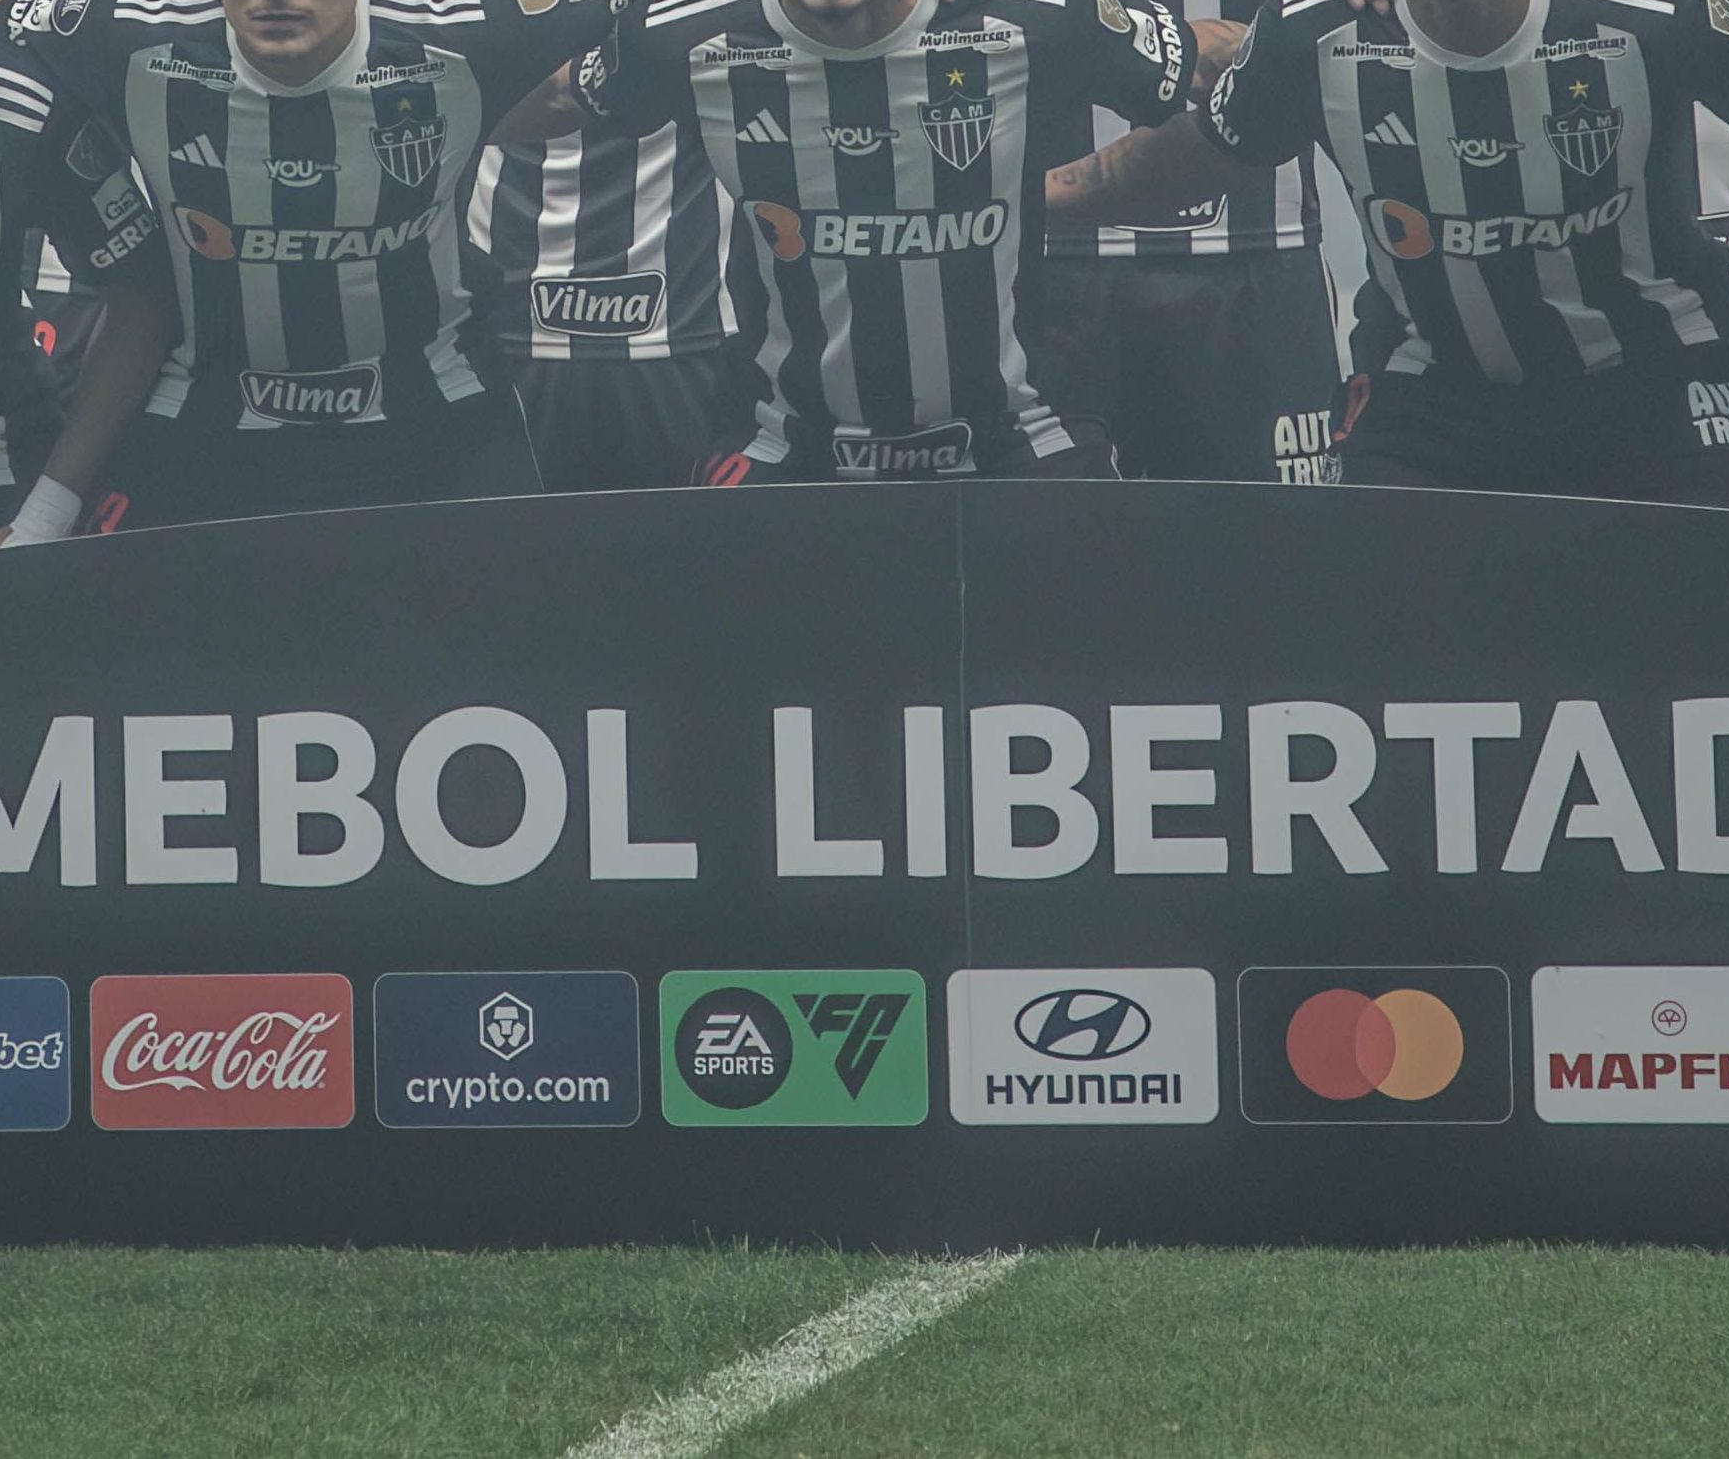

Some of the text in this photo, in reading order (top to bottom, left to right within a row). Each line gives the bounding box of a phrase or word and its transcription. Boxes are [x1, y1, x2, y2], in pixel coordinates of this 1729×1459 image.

[918, 28, 1013, 48] Multimarcas
[1148, 0, 1182, 102] GERDAU
[1535, 37, 1626, 59] Multimarcas
[704, 47, 792, 63] Multimarcas
[148, 58, 237, 84] Multimarcas
[355, 60, 447, 86] Multimarcas
[930, 104, 983, 121] CAM
[1556, 113, 1614, 132] CAM
[381, 124, 436, 144] CAM
[823, 126, 872, 147] YOU
[1449, 137, 1497, 157] YOU
[266, 159, 312, 178] YOU
[240, 205, 442, 261] BETANO
[812, 203, 1005, 257] BETANO
[1442, 189, 1632, 256] BETANO
[537, 284, 651, 325] Vilma
[249, 372, 361, 413] Vilma
[1274, 410, 1331, 457] AUT
[842, 441, 956, 471] Vilma
[694, 1014, 773, 1055] EA
[102, 1011, 341, 1092] Coca-Cola
[694, 1056, 775, 1076] SPORTS
[406, 1071, 610, 1109] crypto.com
[986, 1073, 1182, 1105] HYUNDAI
